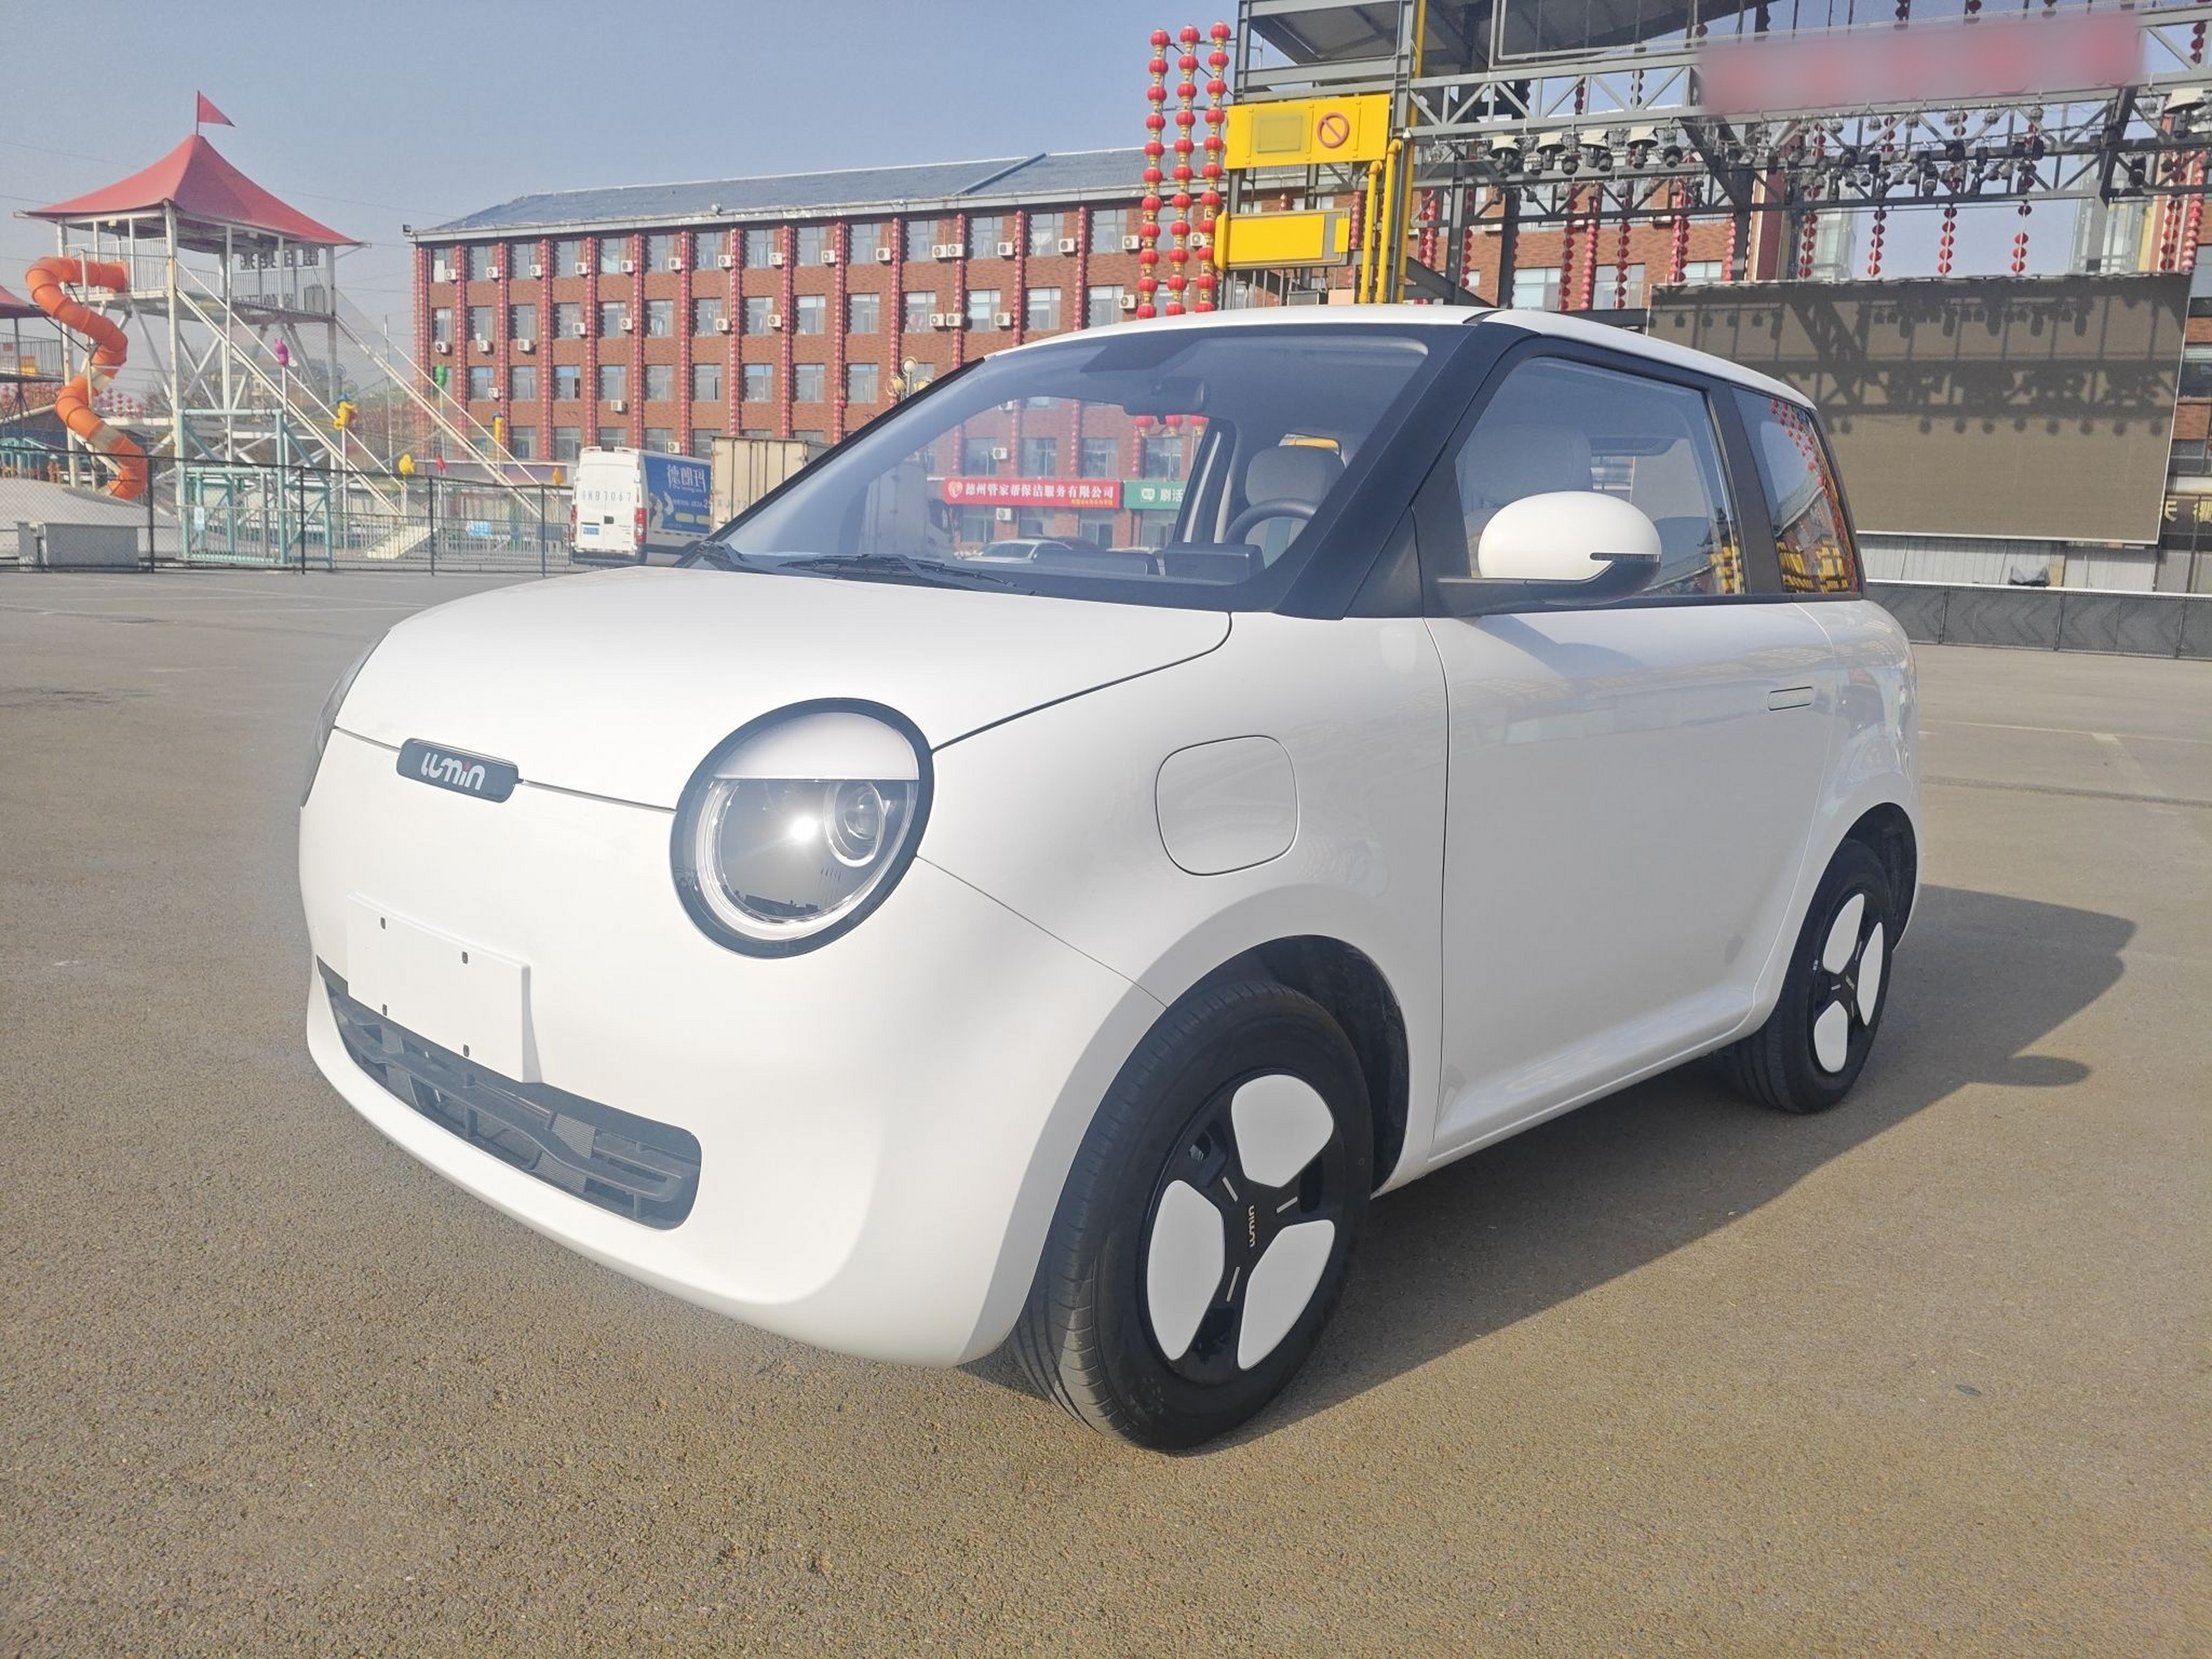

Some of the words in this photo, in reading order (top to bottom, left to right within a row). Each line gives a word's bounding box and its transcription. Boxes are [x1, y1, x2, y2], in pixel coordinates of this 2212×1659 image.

[965, 483, 1113, 498] 德州管家帮保洁服务有限公司
